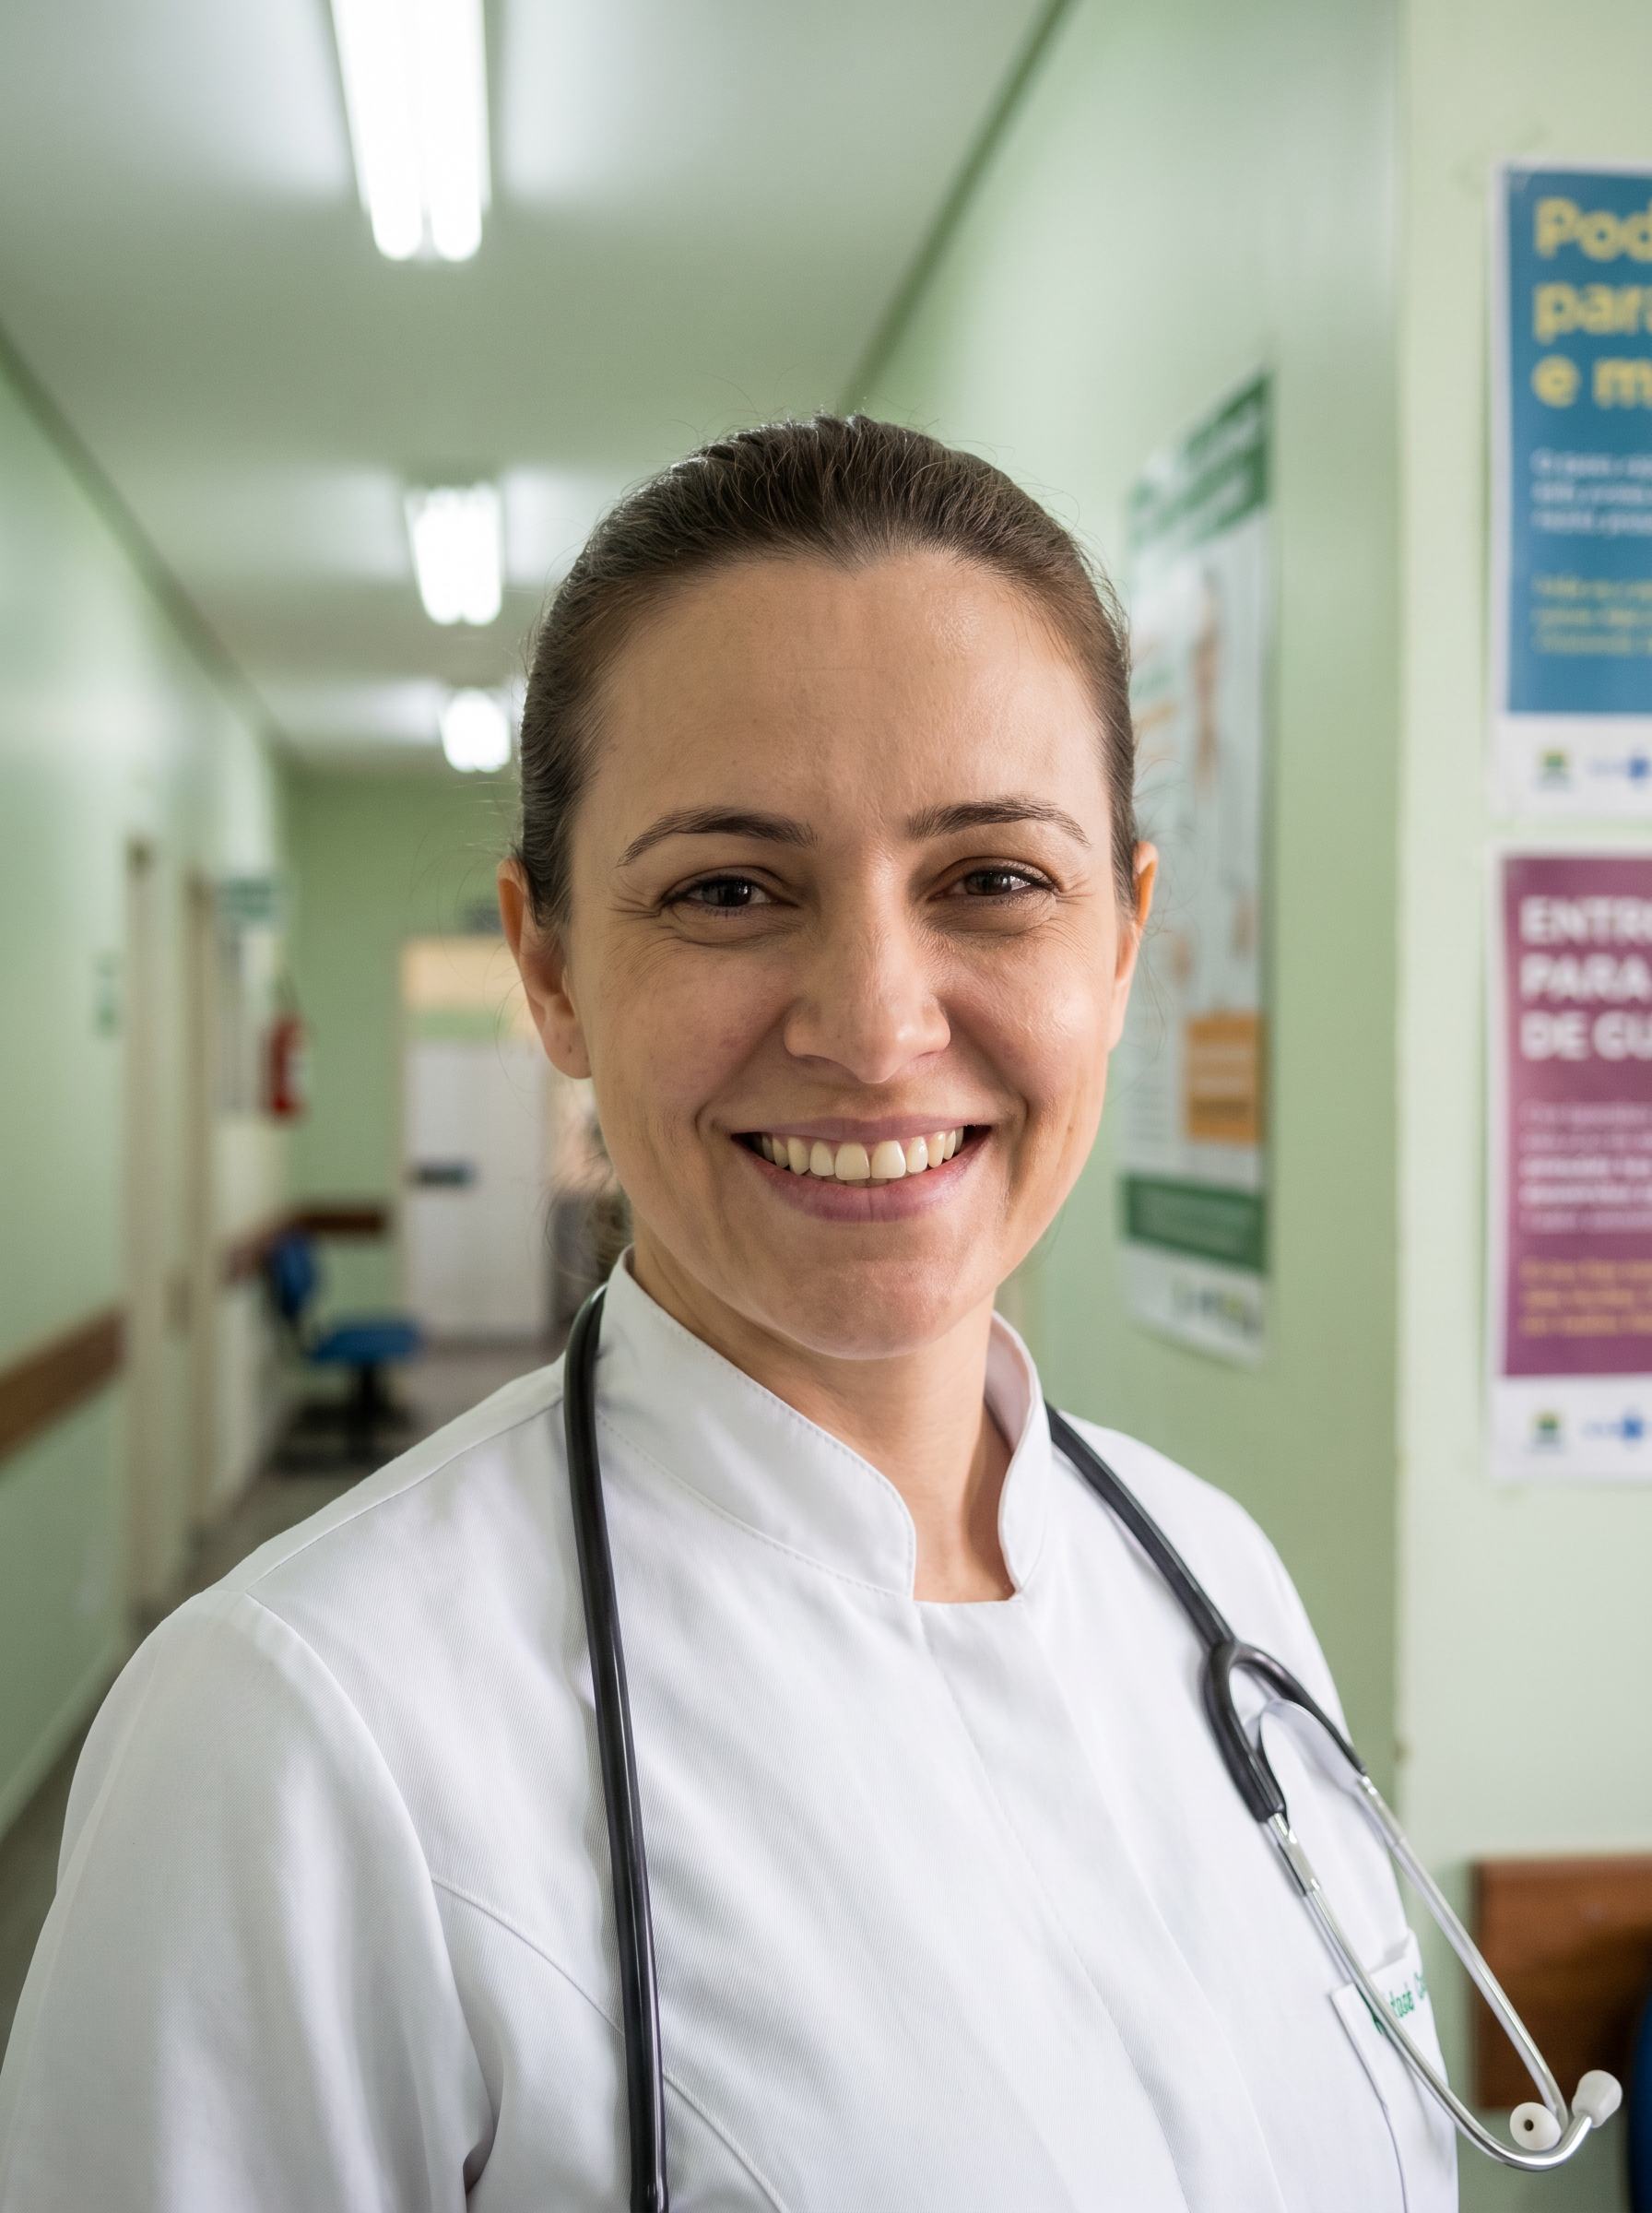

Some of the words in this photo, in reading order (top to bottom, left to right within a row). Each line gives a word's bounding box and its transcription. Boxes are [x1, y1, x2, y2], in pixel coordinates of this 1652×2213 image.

[1534, 282, 1652, 344] par
[1532, 356, 1579, 407] e
[1522, 953, 1651, 1002] PARA
[1522, 1012, 1587, 1059] DE
